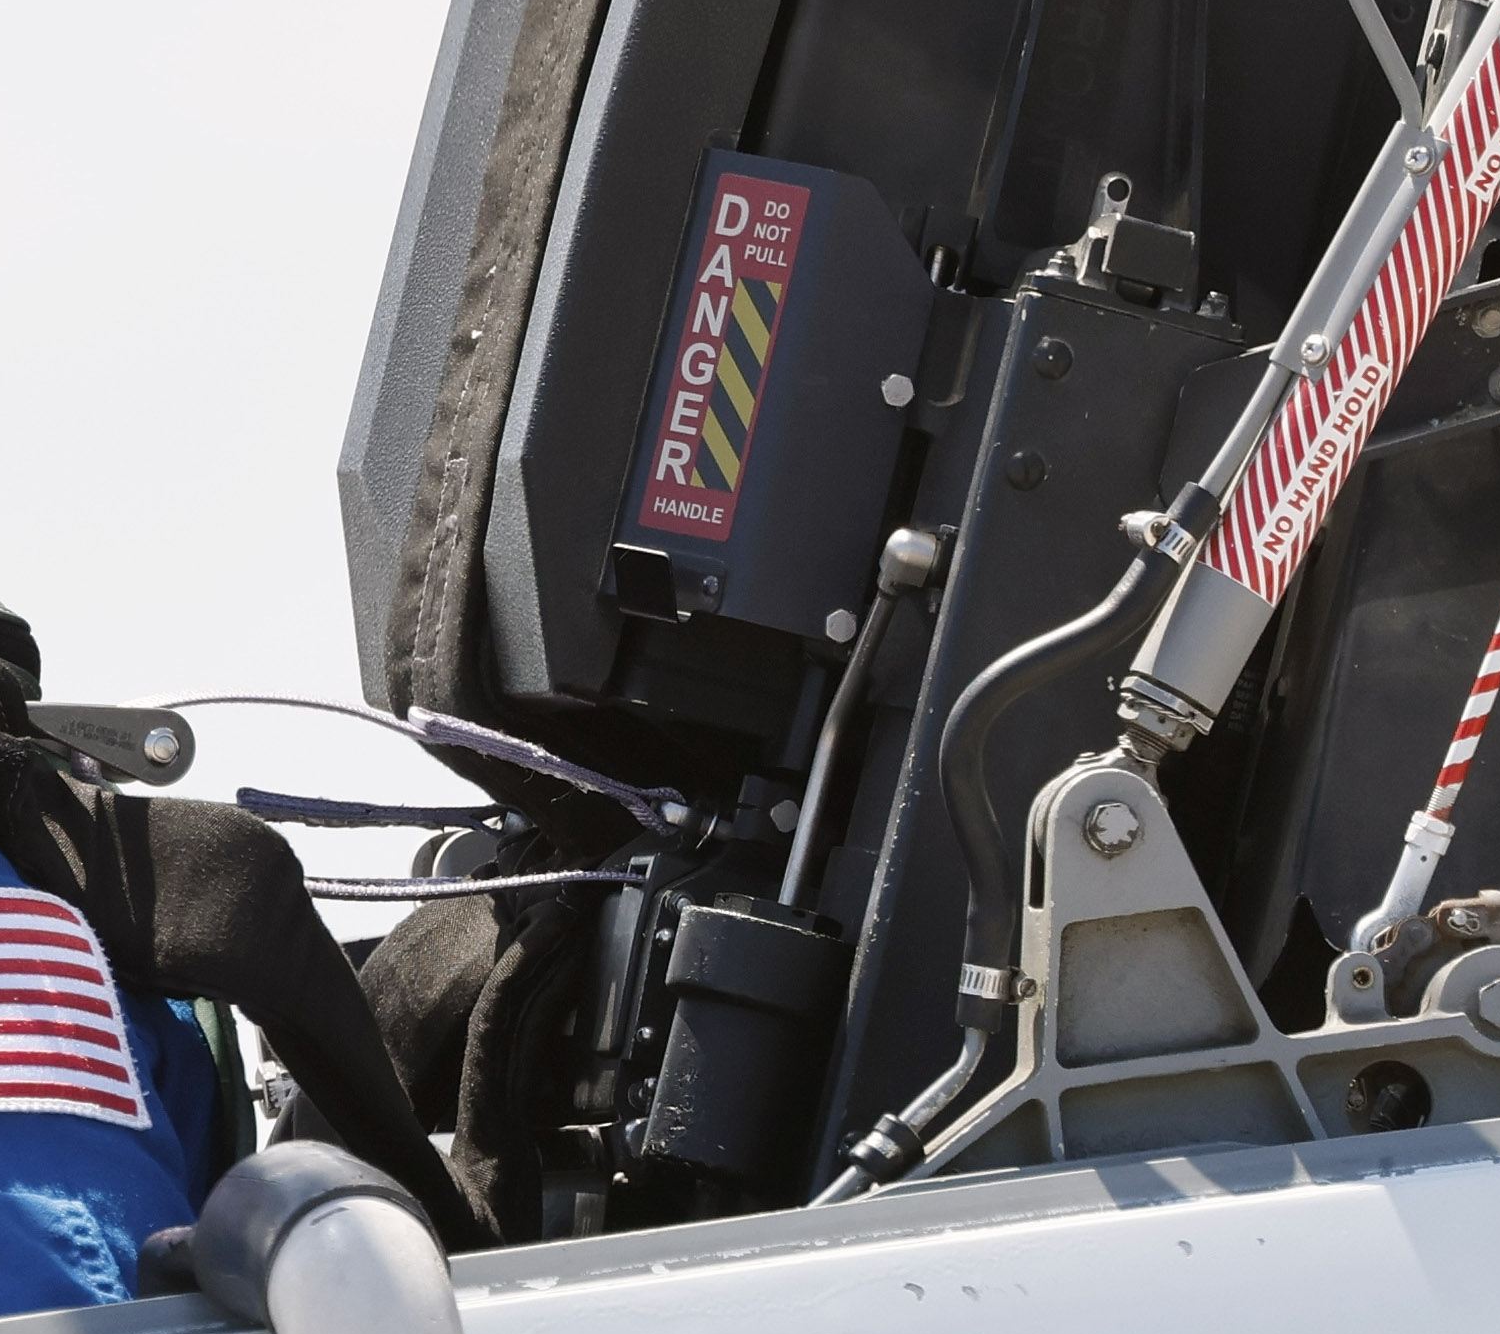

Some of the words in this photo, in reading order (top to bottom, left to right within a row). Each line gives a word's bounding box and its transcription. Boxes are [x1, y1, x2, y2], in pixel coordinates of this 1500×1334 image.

[763, 200, 790, 220] DO
[753, 222, 791, 243] NOT
[744, 244, 787, 267] PULL
[655, 193, 750, 485] DANGER
[1263, 515, 1293, 555] NO
[1287, 439, 1338, 511] HAND
[1333, 365, 1381, 436] HOLD
[653, 496, 724, 524] HANDLE
